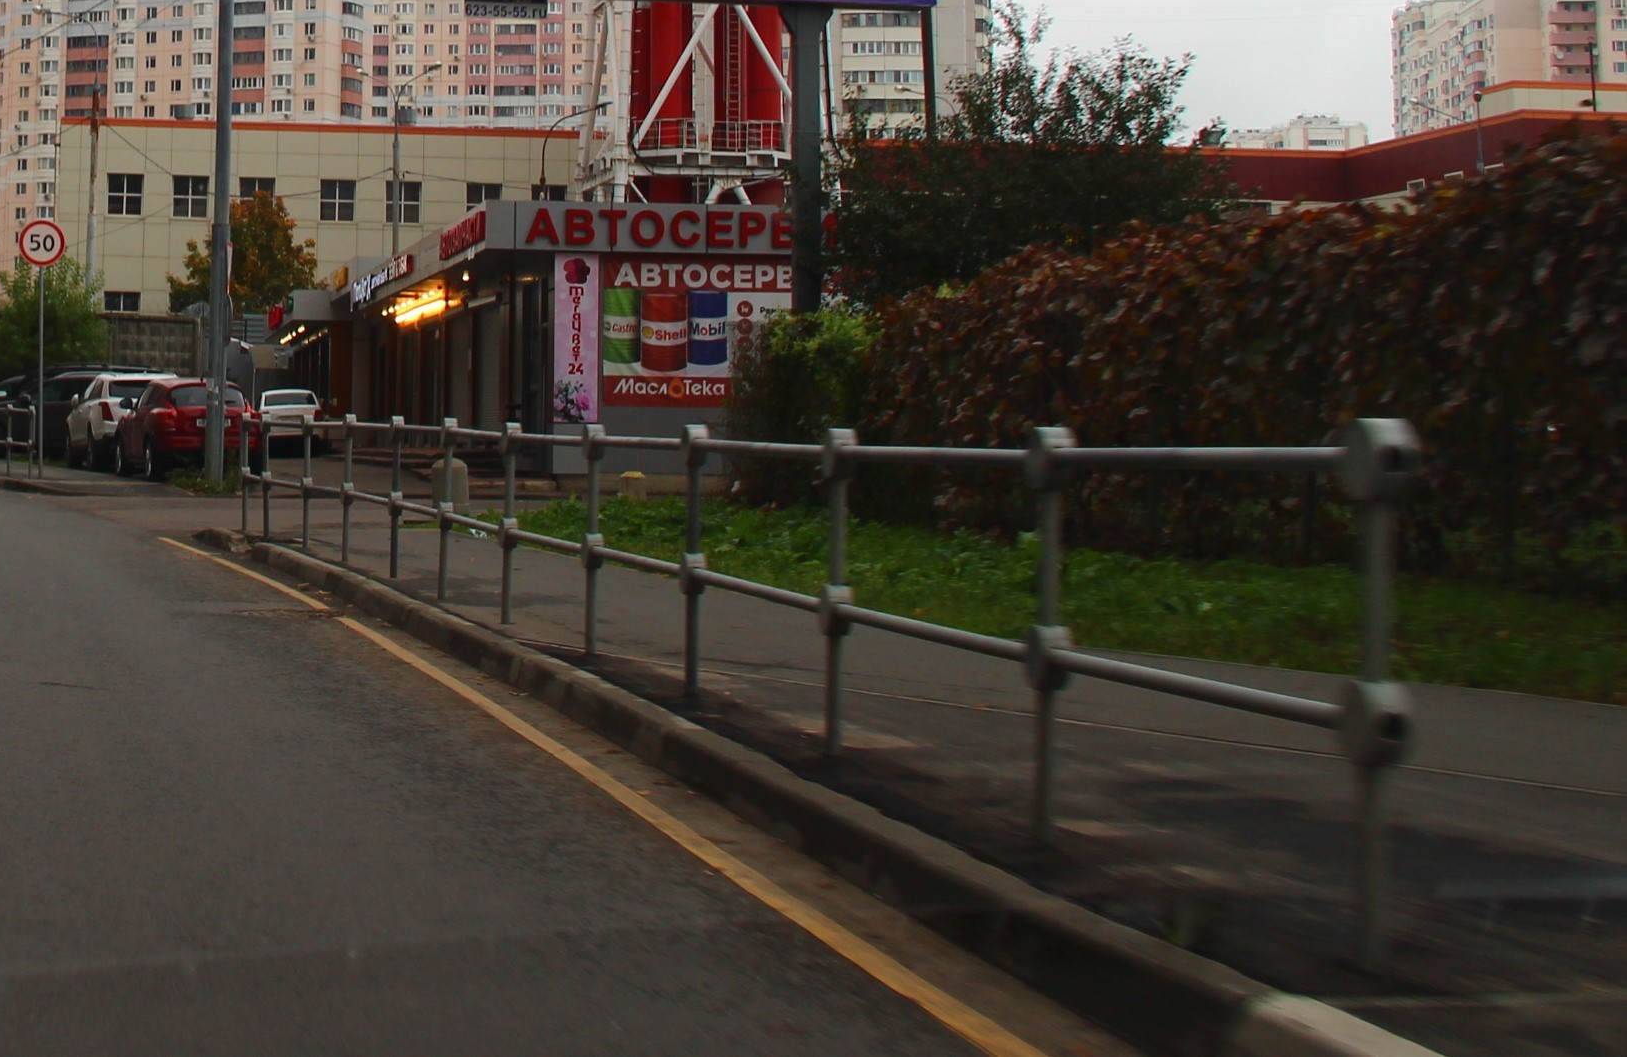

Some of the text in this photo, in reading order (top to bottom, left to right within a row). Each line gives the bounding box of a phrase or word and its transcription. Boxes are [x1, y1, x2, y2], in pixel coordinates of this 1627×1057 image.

[465, 3, 547, 19] 623-55-55.ru
[525, 207, 837, 248] АВТОСЕРВ
[29, 234, 55, 252] 50
[614, 263, 793, 289] АВТОСЕРВ
[612, 323, 639, 333] Castro
[655, 327, 687, 341] Shell
[691, 321, 726, 337] Mobil
[568, 362, 584, 375] 24
